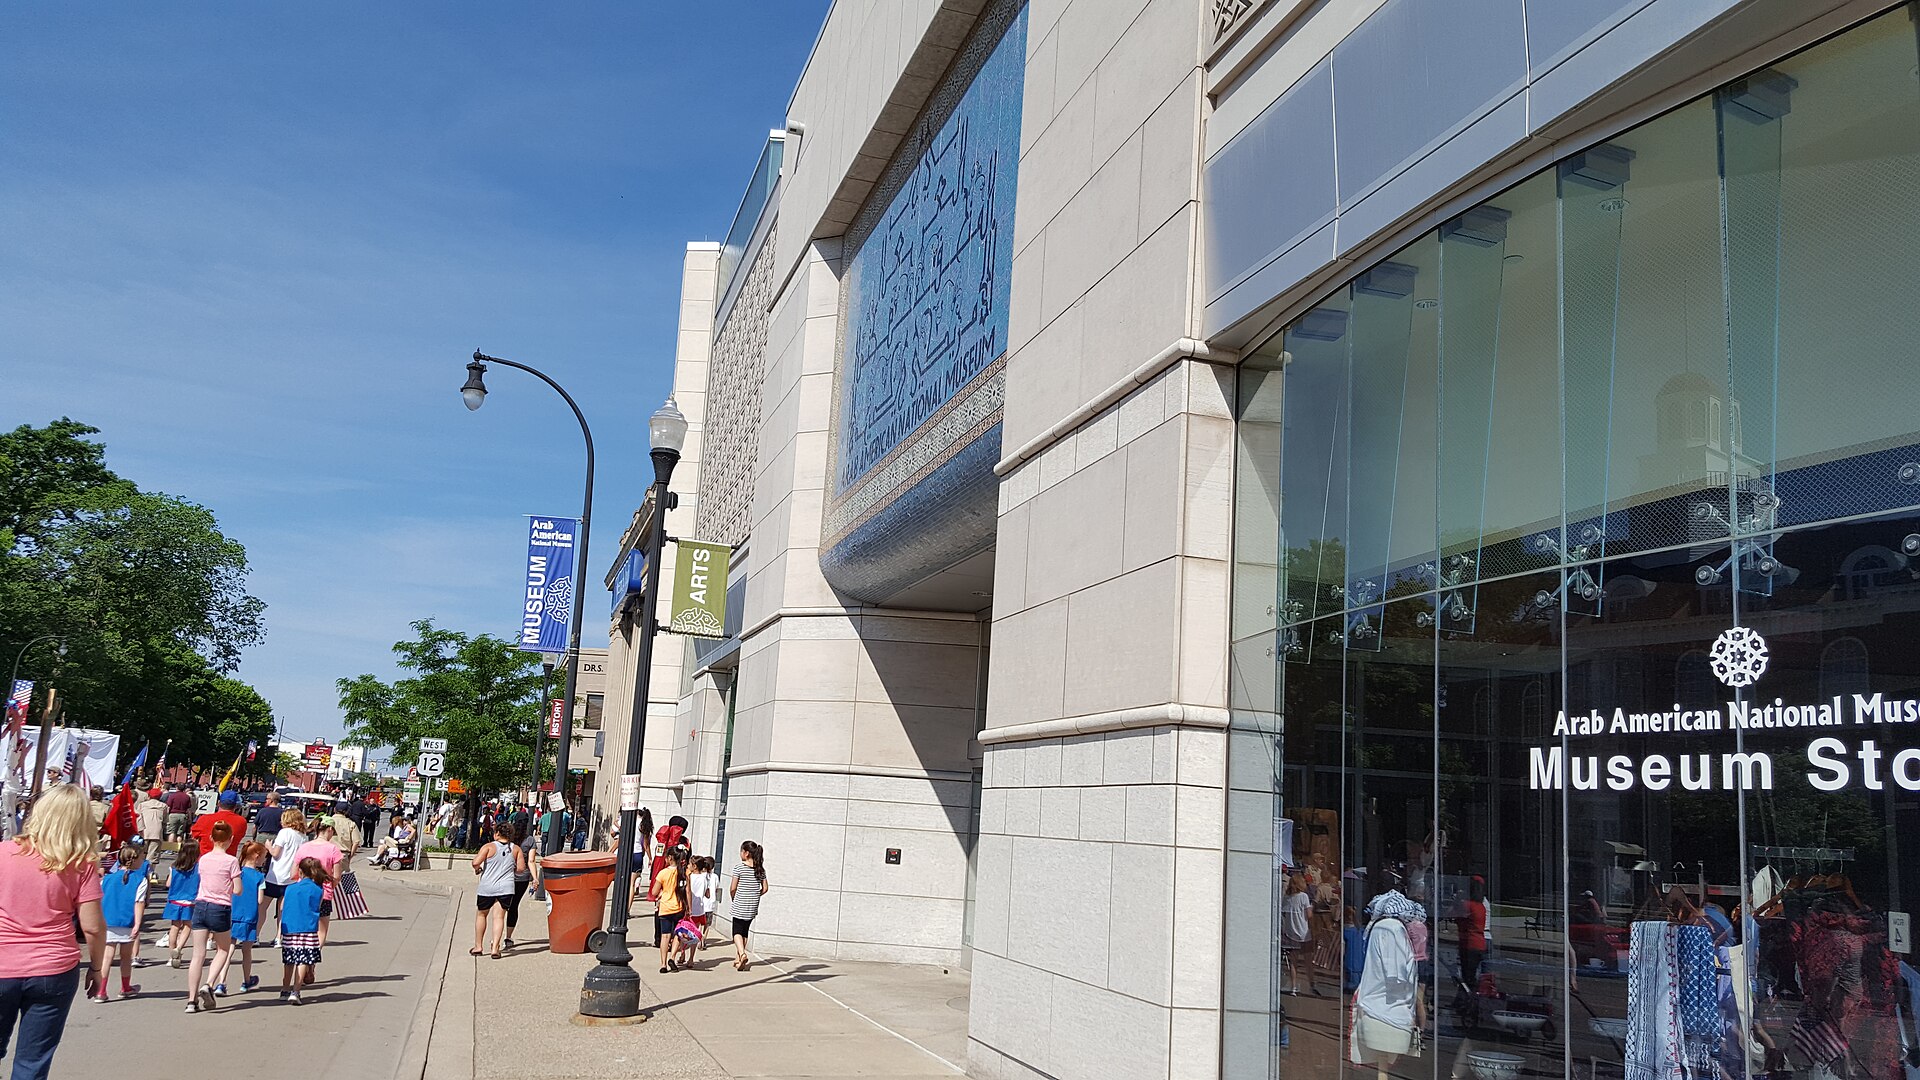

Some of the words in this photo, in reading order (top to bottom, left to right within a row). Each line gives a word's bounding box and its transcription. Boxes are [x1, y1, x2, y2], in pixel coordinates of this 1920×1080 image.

[898, 376, 942, 437] NATIONAL
[945, 325, 995, 398] MUSEUM
[531, 519, 554, 530] Arab
[531, 529, 572, 541] American
[690, 548, 710, 605] ARTS
[523, 555, 546, 644] MUSEUM
[583, 663, 604, 672] DRS.
[551, 701, 562, 736] HISTORY
[1553, 708, 1605, 736] Arab
[1610, 703, 1722, 734] American
[1727, 695, 1843, 731] National
[1851, 692, 1920, 724] Mus
[423, 740, 444, 750] WEST
[423, 757, 440, 772] 12
[1529, 745, 1773, 790] Museum
[199, 800, 208, 811] 2
